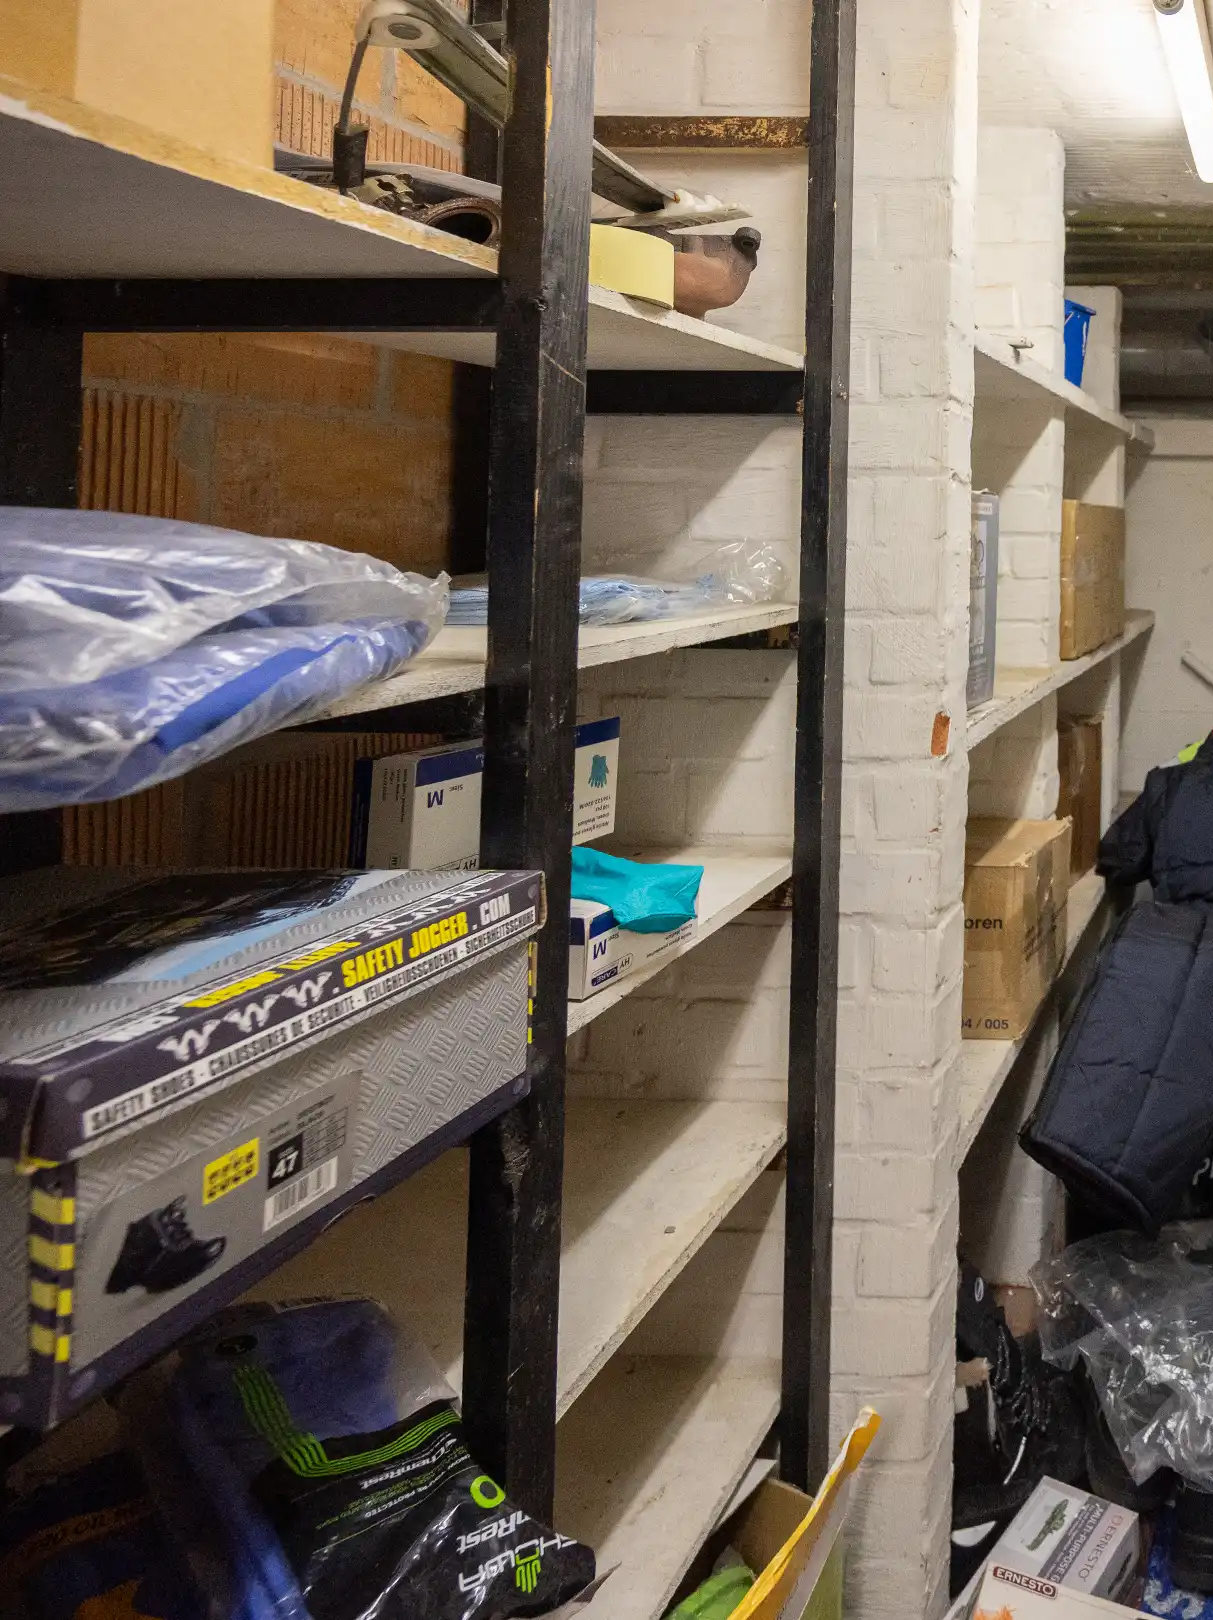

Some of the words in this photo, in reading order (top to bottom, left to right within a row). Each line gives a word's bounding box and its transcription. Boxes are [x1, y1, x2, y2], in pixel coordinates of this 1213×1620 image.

[427, 788, 444, 809] M
[462, 858, 477, 870] HY
[341, 938, 404, 988] SAFETY
[408, 911, 468, 958] JOGGER
[592, 939, 608, 960] M
[619, 957, 630, 968] HY
[91, 1092, 144, 1131] SAFETY
[150, 1069, 195, 1104] SHOES
[208, 1027, 287, 1076] CHAUSSURES
[291, 1017, 305, 1038] DE
[308, 994, 354, 1030] SECURITE
[364, 948, 458, 1001] VEILIGHEIDSSCHOENEN
[464, 908, 534, 954] SICHERHEITSSCHUHE
[985, 1018, 1009, 1030] 005
[272, 1150, 299, 1179] 47
[364, 1490, 416, 1518] PROTECTED
[1058, 1503, 1105, 1578] MULTI-PURPOSE
[1079, 1526, 1116, 1580] ERNESTO
[996, 1568, 1054, 1596] ERNESTO
